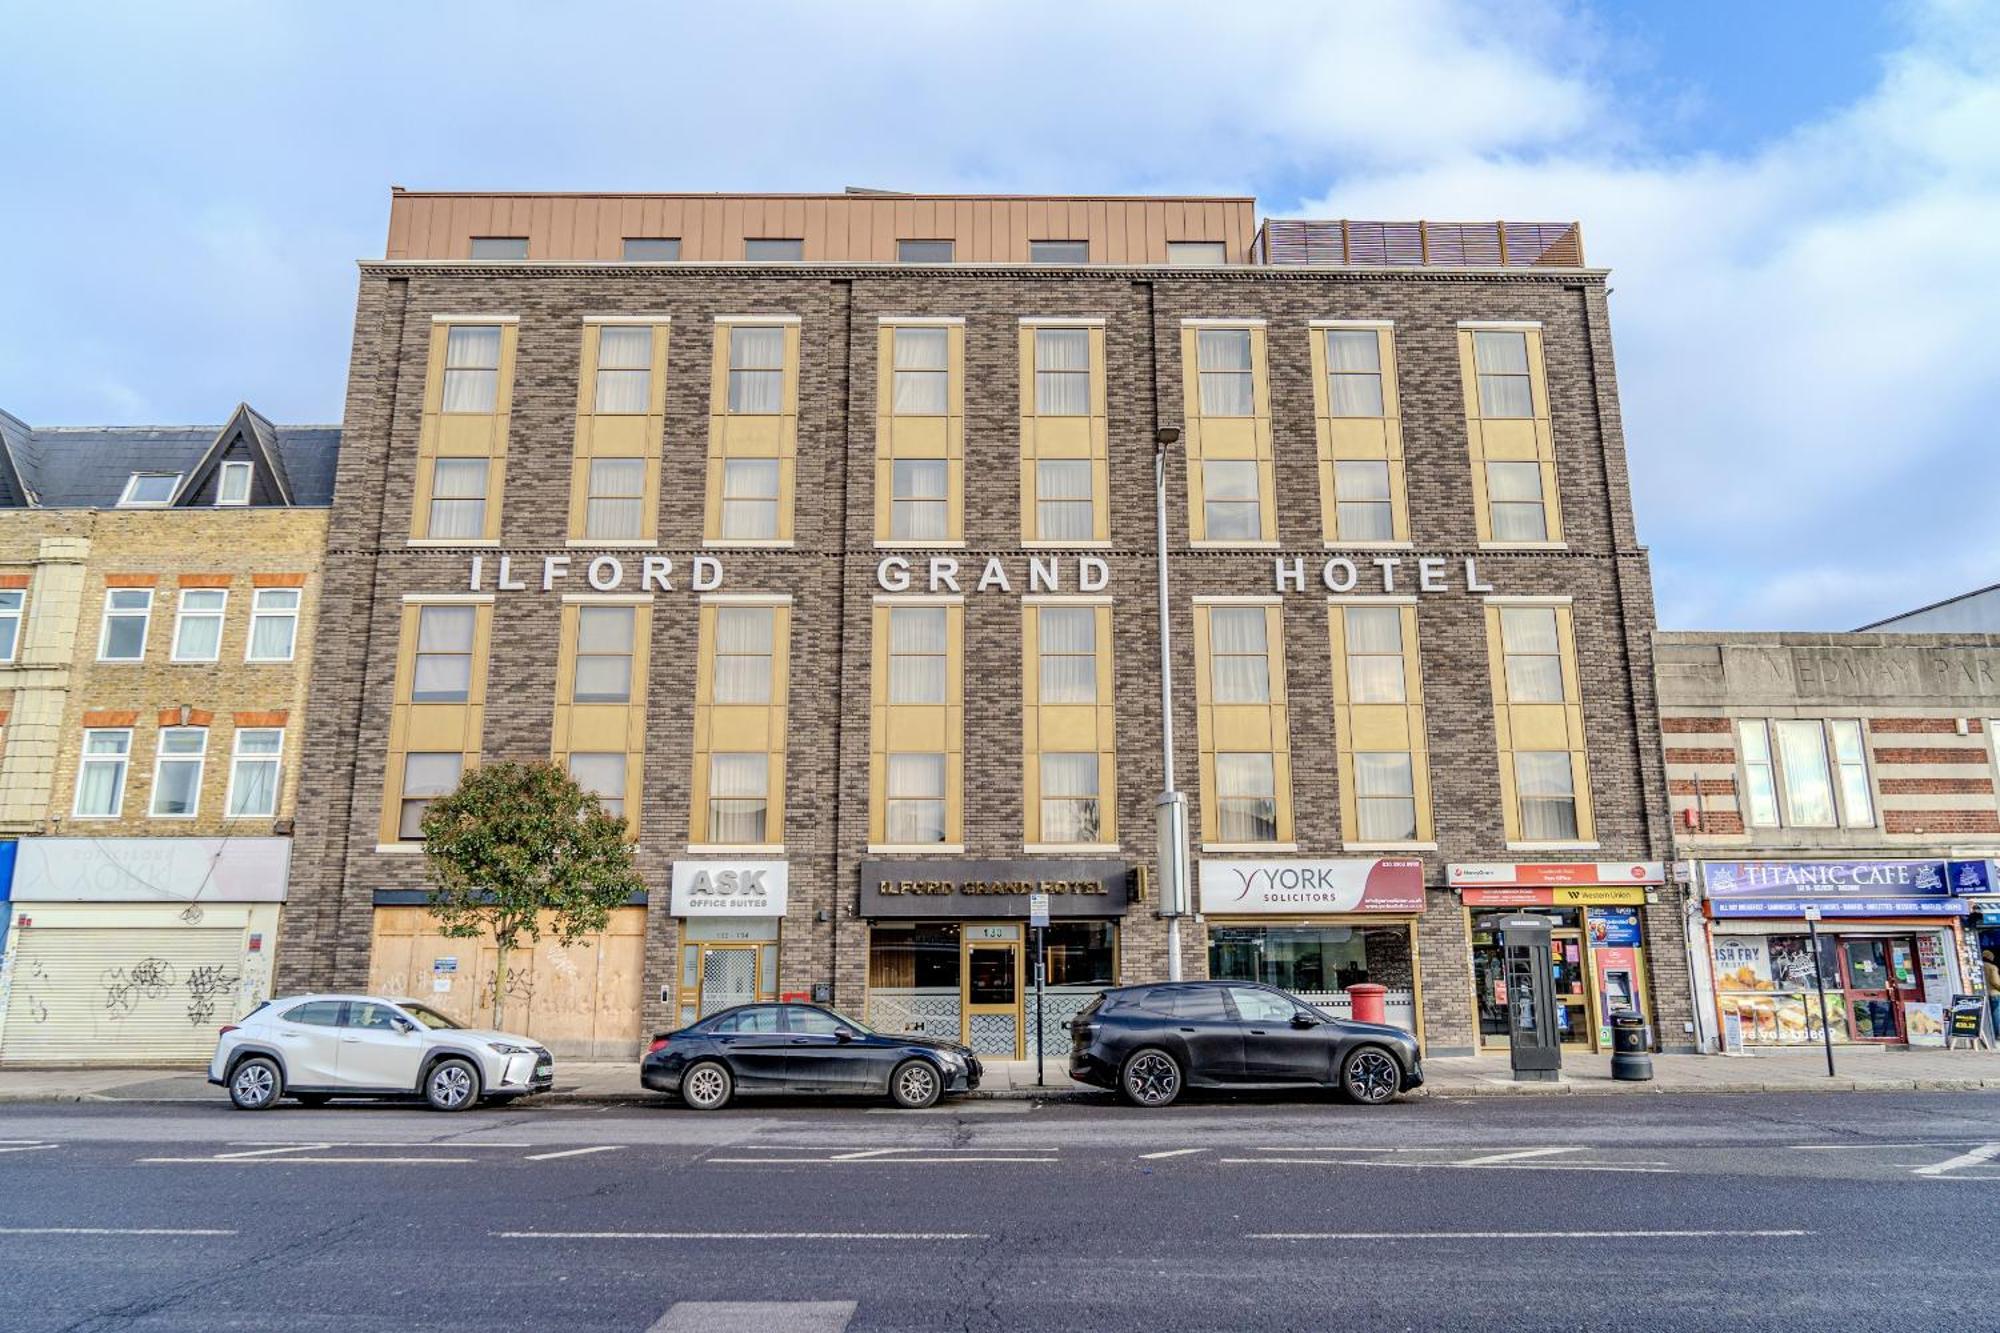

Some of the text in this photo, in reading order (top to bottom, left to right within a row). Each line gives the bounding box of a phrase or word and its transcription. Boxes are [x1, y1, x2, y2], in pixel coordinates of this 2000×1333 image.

[470, 556, 1494, 592] ILFORD GRAND HOTEL
[1763, 657, 1914, 683] MEDWAY
[688, 870, 767, 895] ASK
[1263, 868, 1335, 889] YORK
[1743, 866, 1846, 885] TITANIC
[1852, 865, 1910, 885] CAFE
[879, 880, 1109, 896] ILFORD GRAND HOTEL
[1582, 891, 1631, 899] Western Union
[690, 899, 767, 907] OFFICE SUITES
[1264, 893, 1336, 902] SOLICITORS
[1714, 948, 1735, 960] ISH
